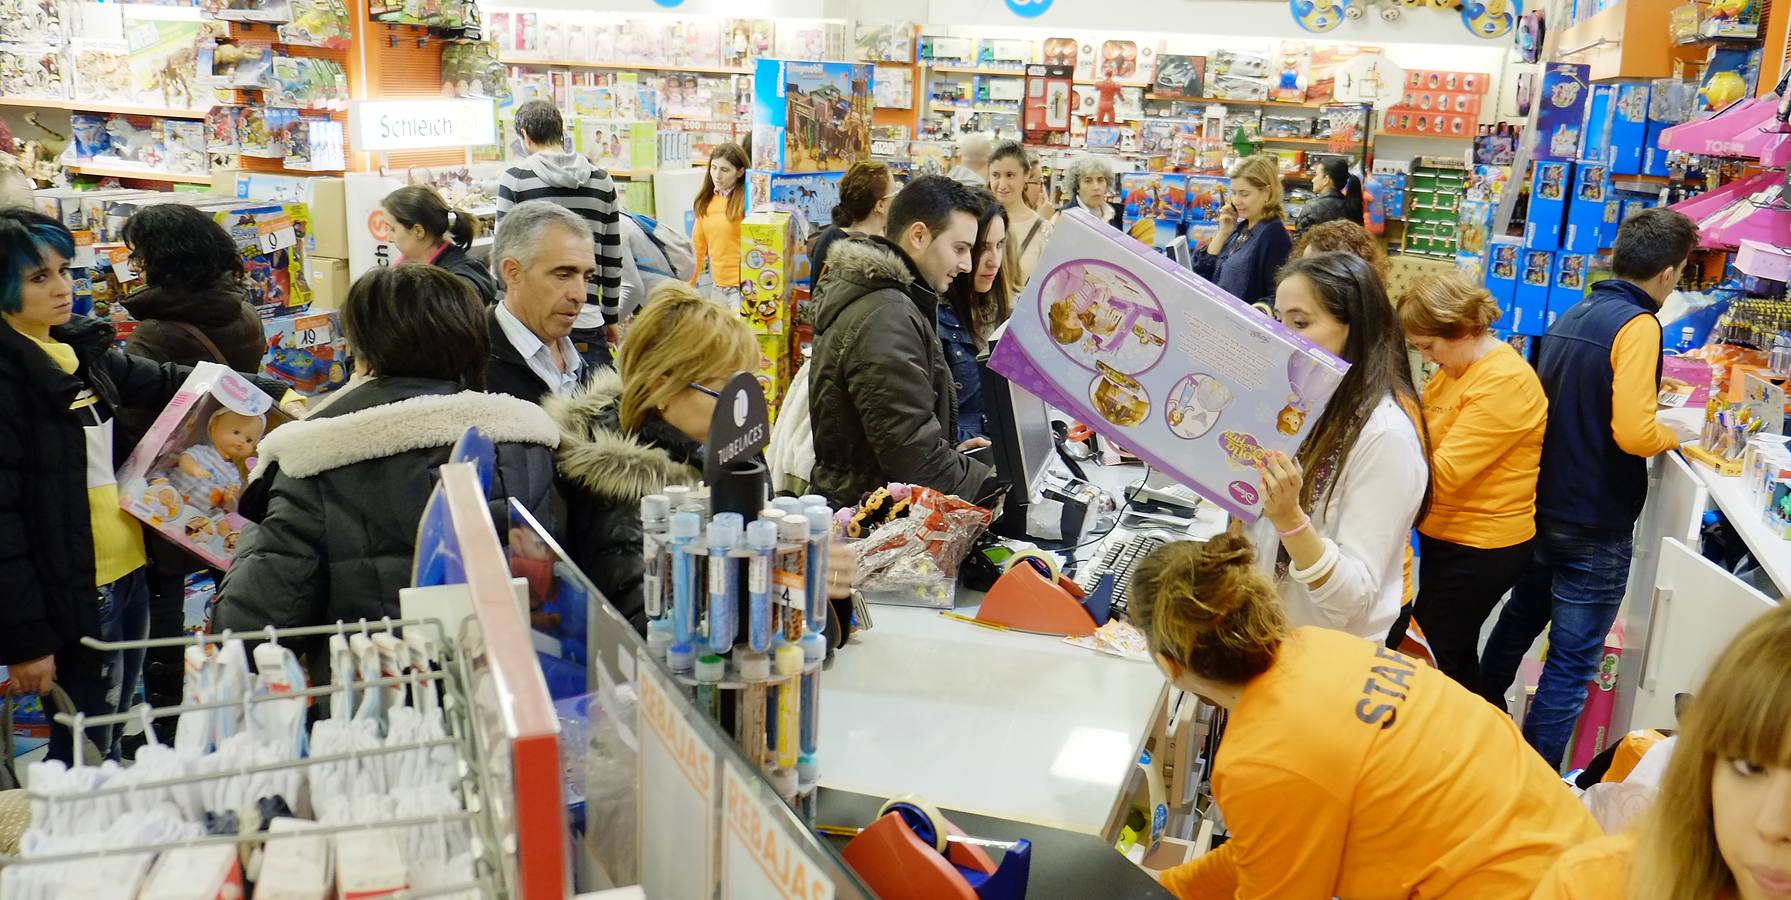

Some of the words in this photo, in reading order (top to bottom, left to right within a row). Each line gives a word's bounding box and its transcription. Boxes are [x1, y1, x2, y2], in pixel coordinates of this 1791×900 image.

[380, 113, 454, 138] Schleich
[268, 231, 278, 250] 9
[301, 328, 316, 345] 19
[717, 423, 763, 466] TUBELACES
[782, 586, 791, 608] 4
[1355, 638, 1417, 730] STAF
[641, 672, 711, 791] REBAJAS
